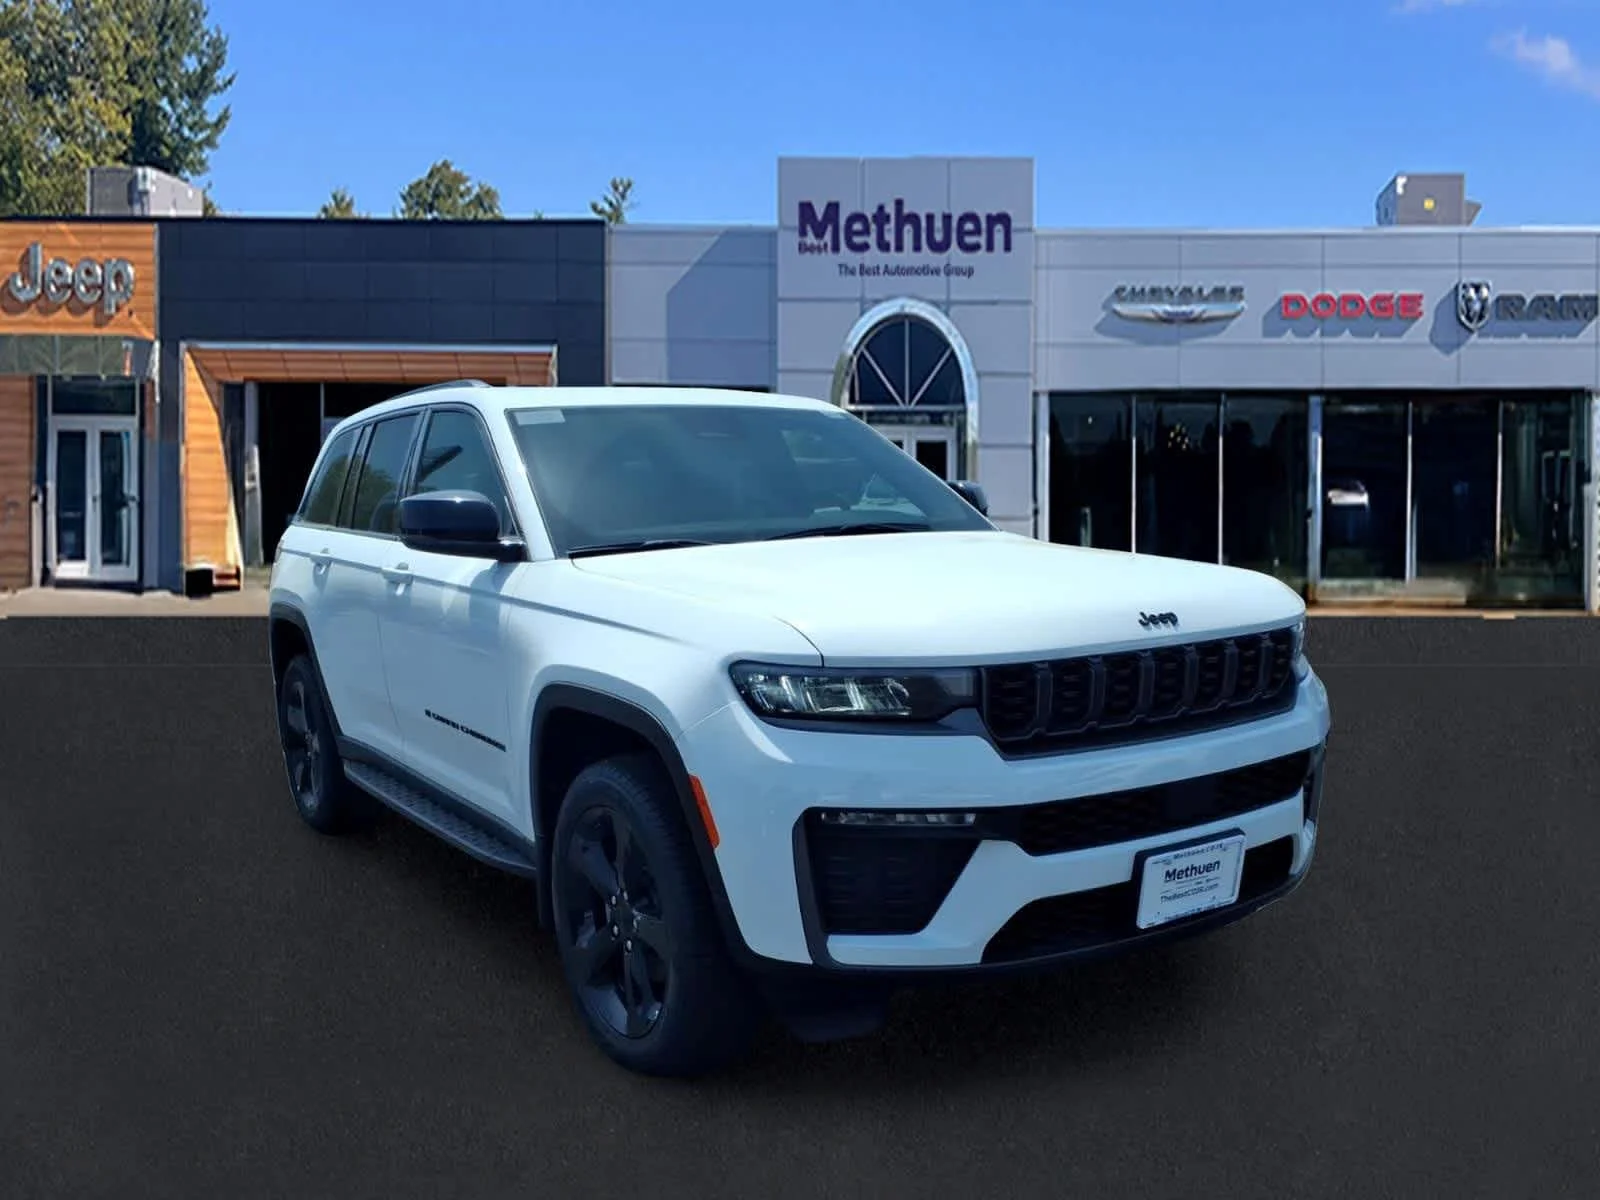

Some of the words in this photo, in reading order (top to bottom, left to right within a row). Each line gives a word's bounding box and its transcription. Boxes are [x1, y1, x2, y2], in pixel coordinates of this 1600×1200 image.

[798, 198, 1013, 253] Methuen
[9, 242, 136, 315] Jeep
[838, 263, 857, 276] The
[859, 263, 881, 277] Best
[882, 263, 941, 277] Automotive
[943, 263, 974, 279] Group
[1281, 293, 1424, 319] DODGE
[1495, 295, 1598, 321] RAM
[1138, 611, 1178, 627] Jeep
[1163, 860, 1220, 883] Methuen
